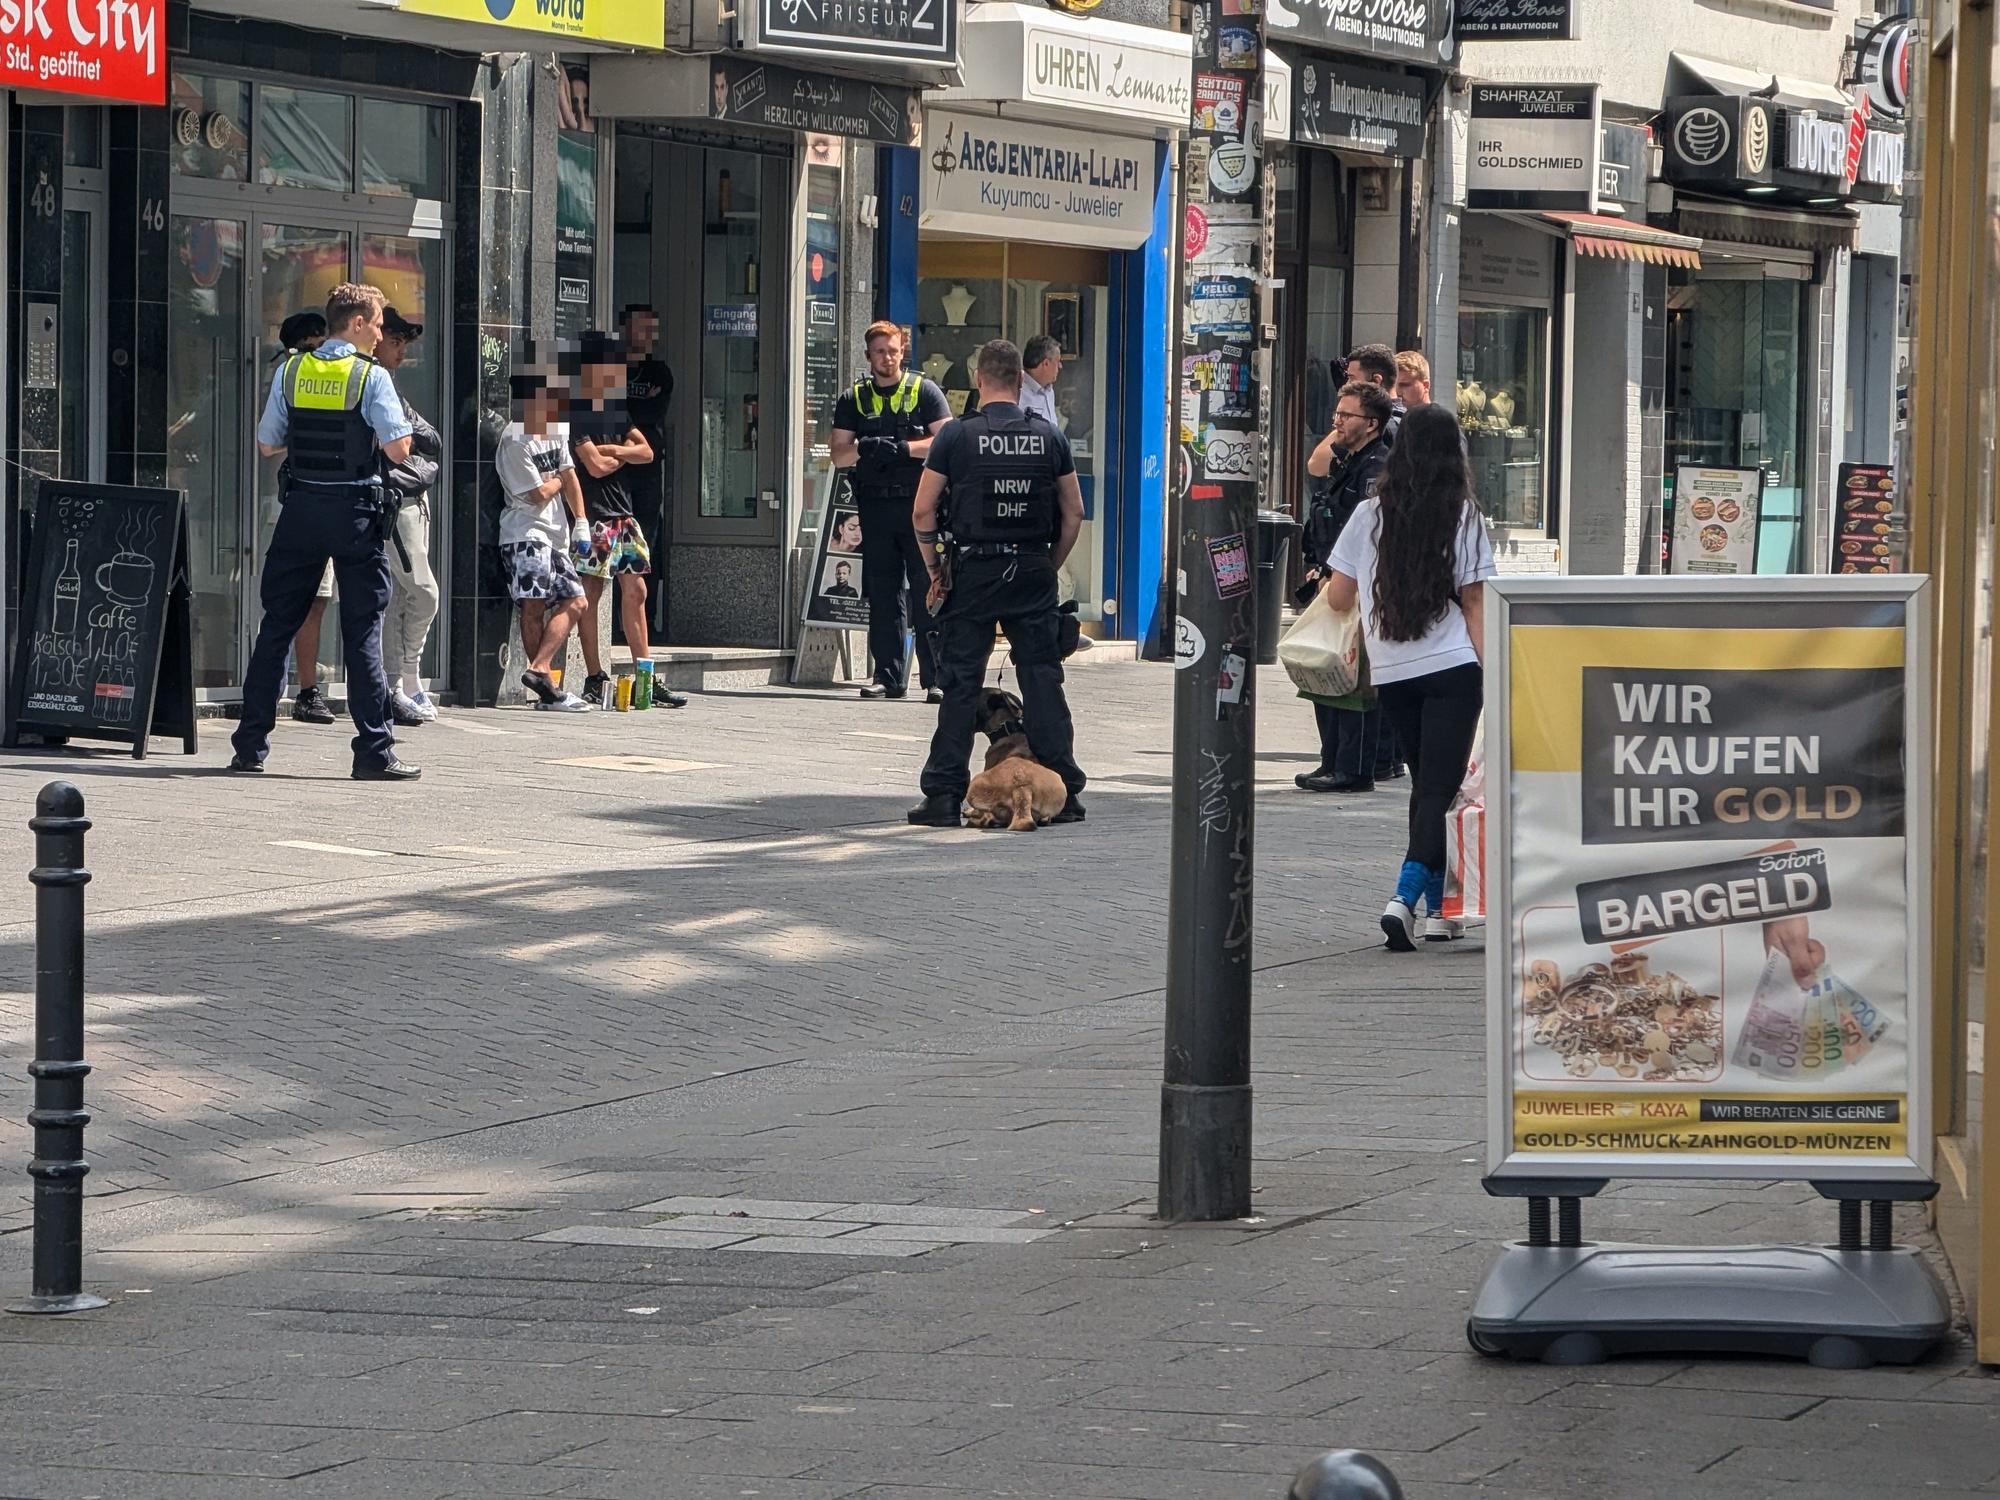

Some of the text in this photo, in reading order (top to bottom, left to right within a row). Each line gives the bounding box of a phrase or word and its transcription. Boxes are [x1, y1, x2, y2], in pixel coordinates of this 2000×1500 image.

[822, 2, 908, 28] FRISEUR
[1460, 23, 1489, 31] ABEND
[1500, 22, 1559, 30] BRAUTMODEN
[67, 0, 156, 76] City
[1334, 15, 1425, 48] ABEND & BRAUTMODEN
[6, 42, 101, 80] Std. geöffnet
[1035, 42, 1100, 92] UHREN
[1105, 53, 1189, 114] Lennartz
[1197, 77, 1242, 93] SEKTION
[1330, 72, 1421, 126] Änderungsschneiderei
[1479, 90, 1563, 103] SHAHRAZAT
[1520, 103, 1575, 113] JUWELIER
[764, 104, 870, 136] HERZLICH WILLKOMMEN
[1351, 119, 1398, 148] & Boutique
[1478, 141, 1502, 152] IHR
[959, 131, 1139, 191] ARGJENTARIA-LLAPI
[1477, 156, 1583, 169] GOLDSCHMIED
[31, 183, 56, 217] 48
[900, 194, 913, 217] 42
[981, 180, 1050, 211] Kuyumcu
[1064, 190, 1123, 218] Juwelier
[142, 198, 165, 231] 46
[565, 225, 574, 239] Mit
[558, 240, 593, 254] Ohne Termin
[1202, 284, 1237, 295] HELLO
[707, 320, 758, 331] freihalten
[713, 308, 757, 321] Eingang
[298, 378, 344, 397] POLIZEI
[978, 435, 1045, 455] POLIZEI
[994, 479, 1032, 494] NRW
[997, 502, 1028, 518] DHF
[88, 603, 137, 631] Caffe
[34, 631, 82, 656] Kölsch
[31, 654, 88, 690] 1,30€
[1612, 682, 1712, 725] WIR
[1613, 735, 1820, 775] KAUFEN
[1613, 784, 1863, 827] IHR GOLD
[1758, 851, 1827, 873] Sofort
[1596, 872, 1818, 940] BARGELD
[1521, 1101, 1886, 1120] JUWELIER KAYA WIR BERATEN SIE GERNE
[1523, 1130, 1891, 1151] GOLD-SCHMUCK-ZAHNGOLD-MÜNZEN
